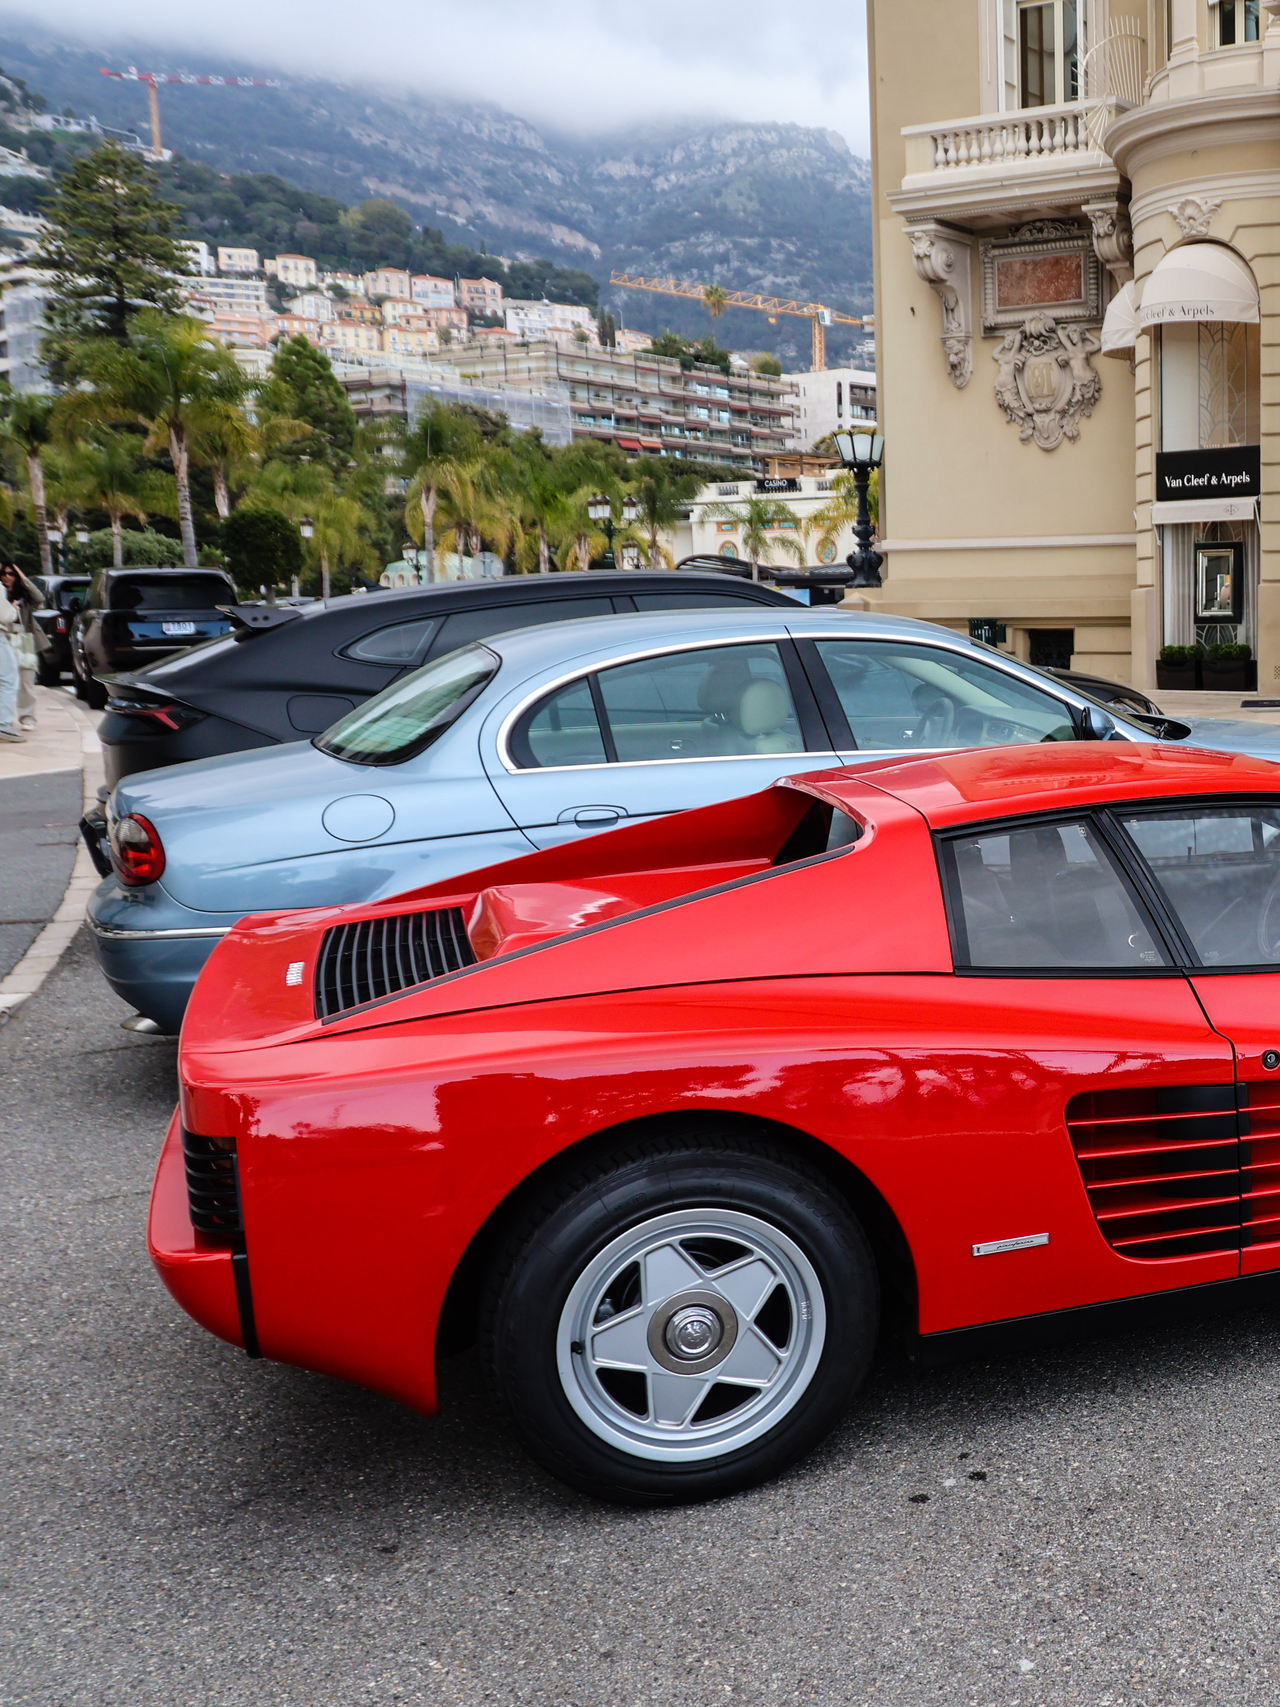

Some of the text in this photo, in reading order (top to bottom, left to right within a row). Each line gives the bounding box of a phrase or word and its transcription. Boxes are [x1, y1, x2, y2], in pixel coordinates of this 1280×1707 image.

[1146, 306, 1166, 320] Cleef
[1168, 307, 1175, 317] &
[1180, 304, 1215, 319] Arpels
[764, 479, 787, 487] CASINO
[1164, 471, 1250, 488] Van Cleef & Arpels
